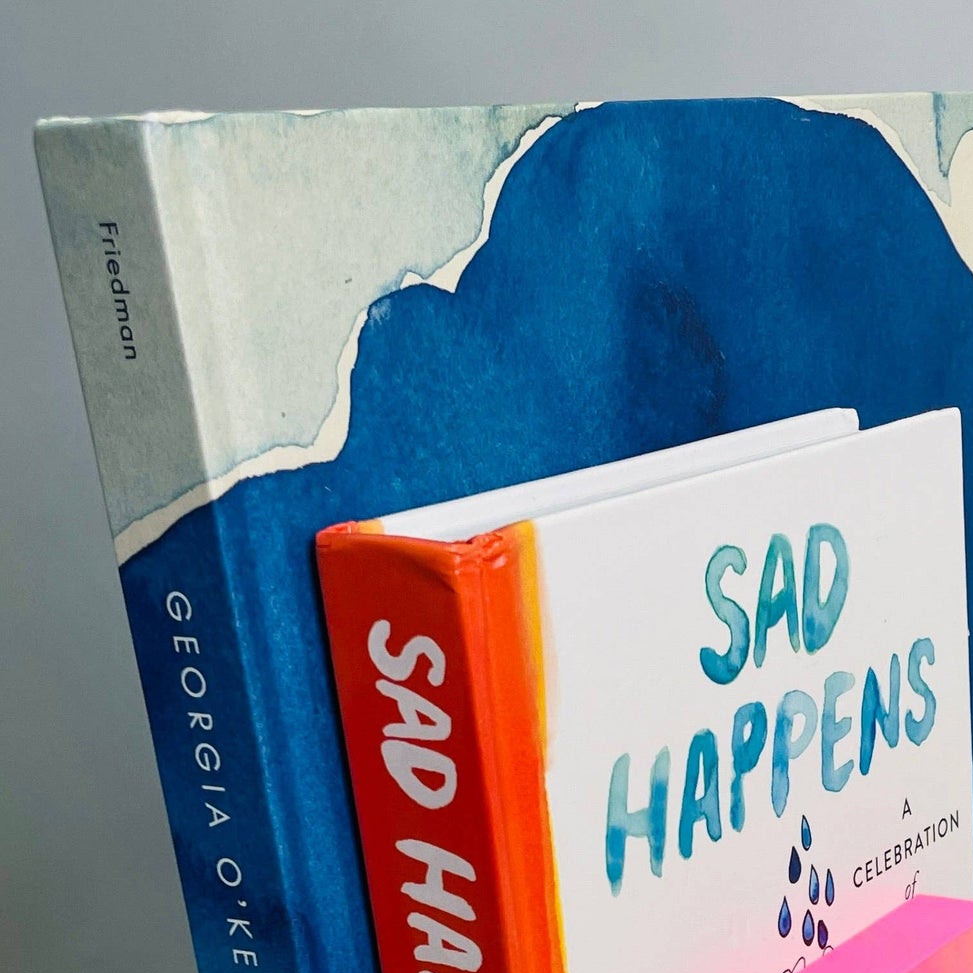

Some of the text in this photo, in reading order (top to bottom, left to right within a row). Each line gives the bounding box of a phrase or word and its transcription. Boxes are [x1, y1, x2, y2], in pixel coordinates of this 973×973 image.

[100, 221, 136, 360] Friedman
[699, 523, 850, 685] SAD
[166, 590, 231, 828] GEORGIA
[367, 619, 458, 810] SAD
[605, 637, 937, 897] HAPPENS
[852, 810, 960, 888] CELEBRATION
[901, 798, 913, 820] A
[904, 870, 920, 900] of
